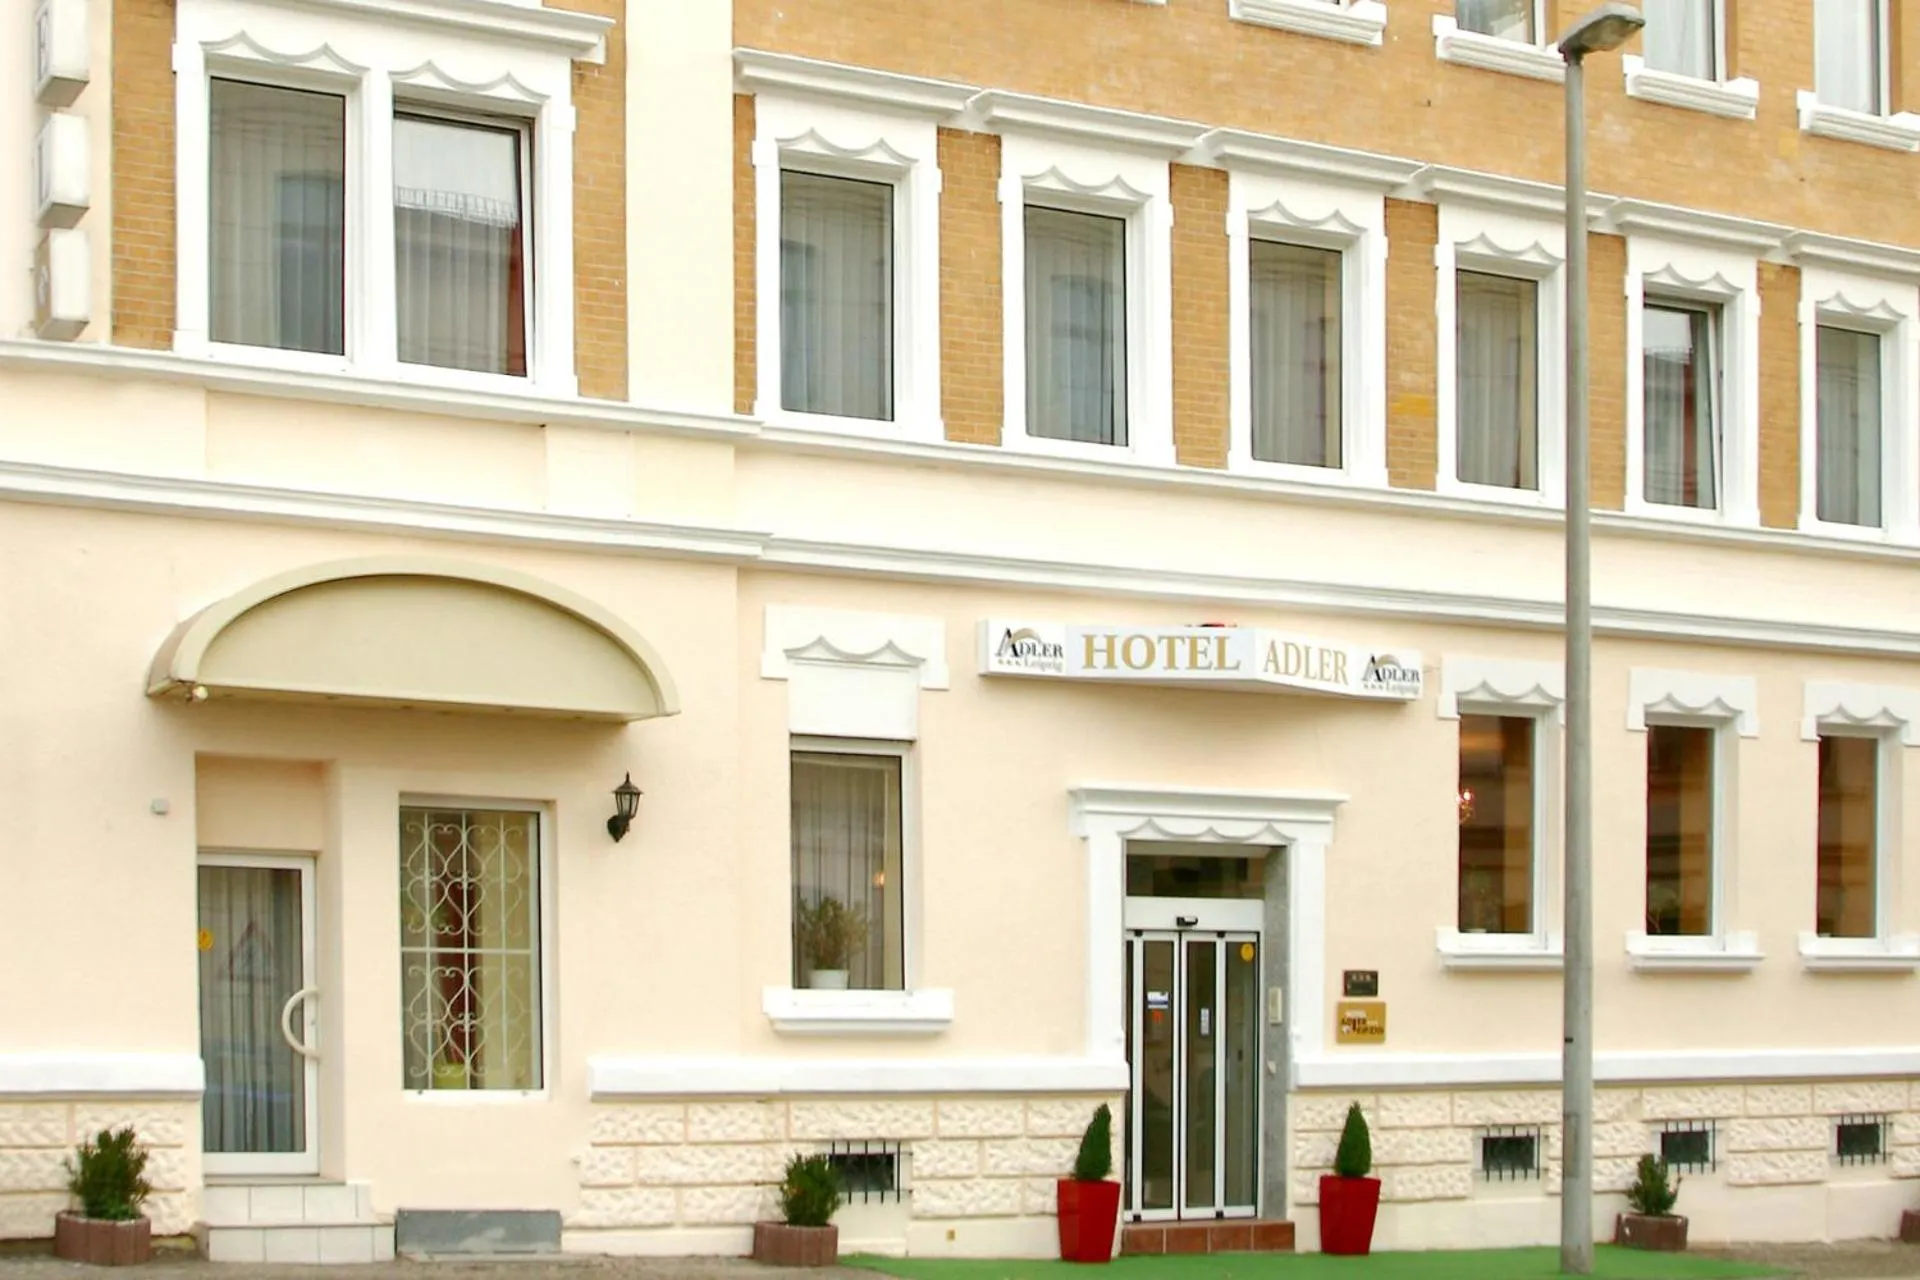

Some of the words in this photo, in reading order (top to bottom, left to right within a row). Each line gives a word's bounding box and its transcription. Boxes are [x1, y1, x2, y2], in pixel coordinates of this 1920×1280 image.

[994, 626, 1064, 658] ADLER
[1081, 633, 1241, 671] HOTEL
[1263, 638, 1350, 686] ADLER
[1361, 653, 1421, 683] ADLER
